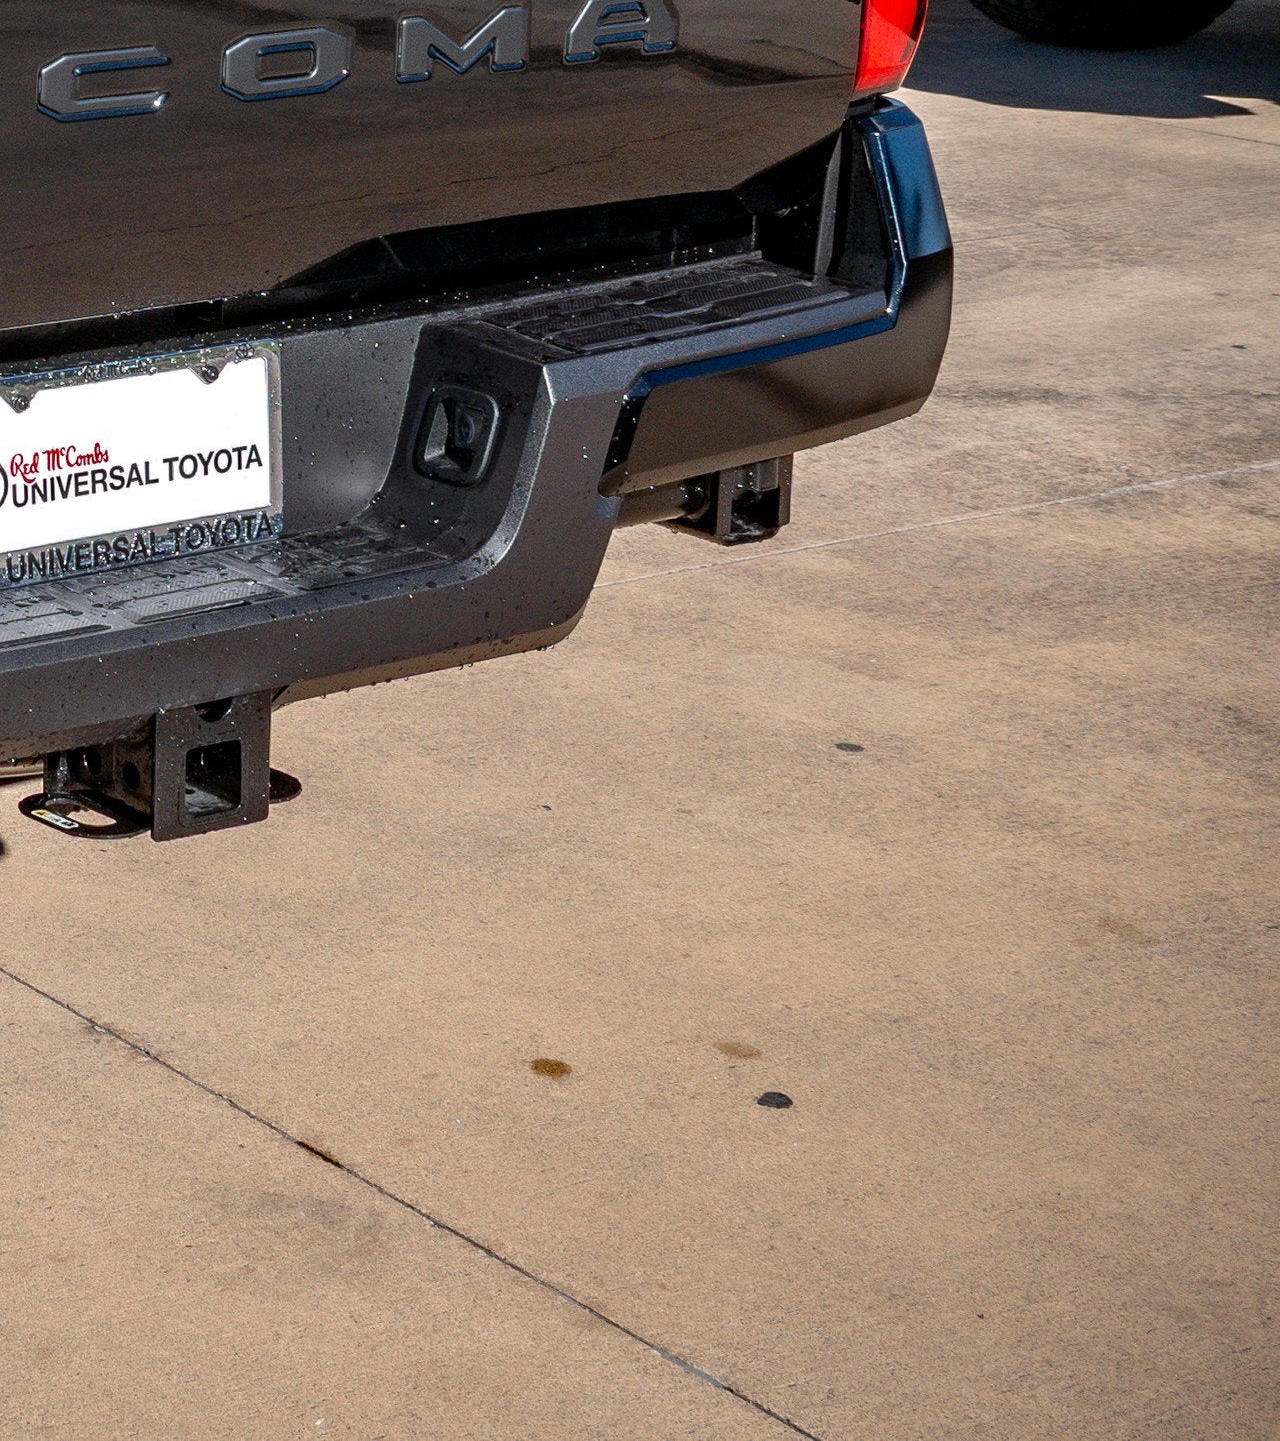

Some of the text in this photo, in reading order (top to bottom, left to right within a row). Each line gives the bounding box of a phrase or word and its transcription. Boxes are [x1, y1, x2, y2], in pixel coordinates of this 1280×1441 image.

[10, 442, 109, 483] Red McCombs
[11, 461, 159, 508] UNIVERSAL
[163, 444, 263, 482] TOYOTA
[6, 530, 166, 582] UNIVERSAL
[170, 513, 275, 554] TOYOTA
